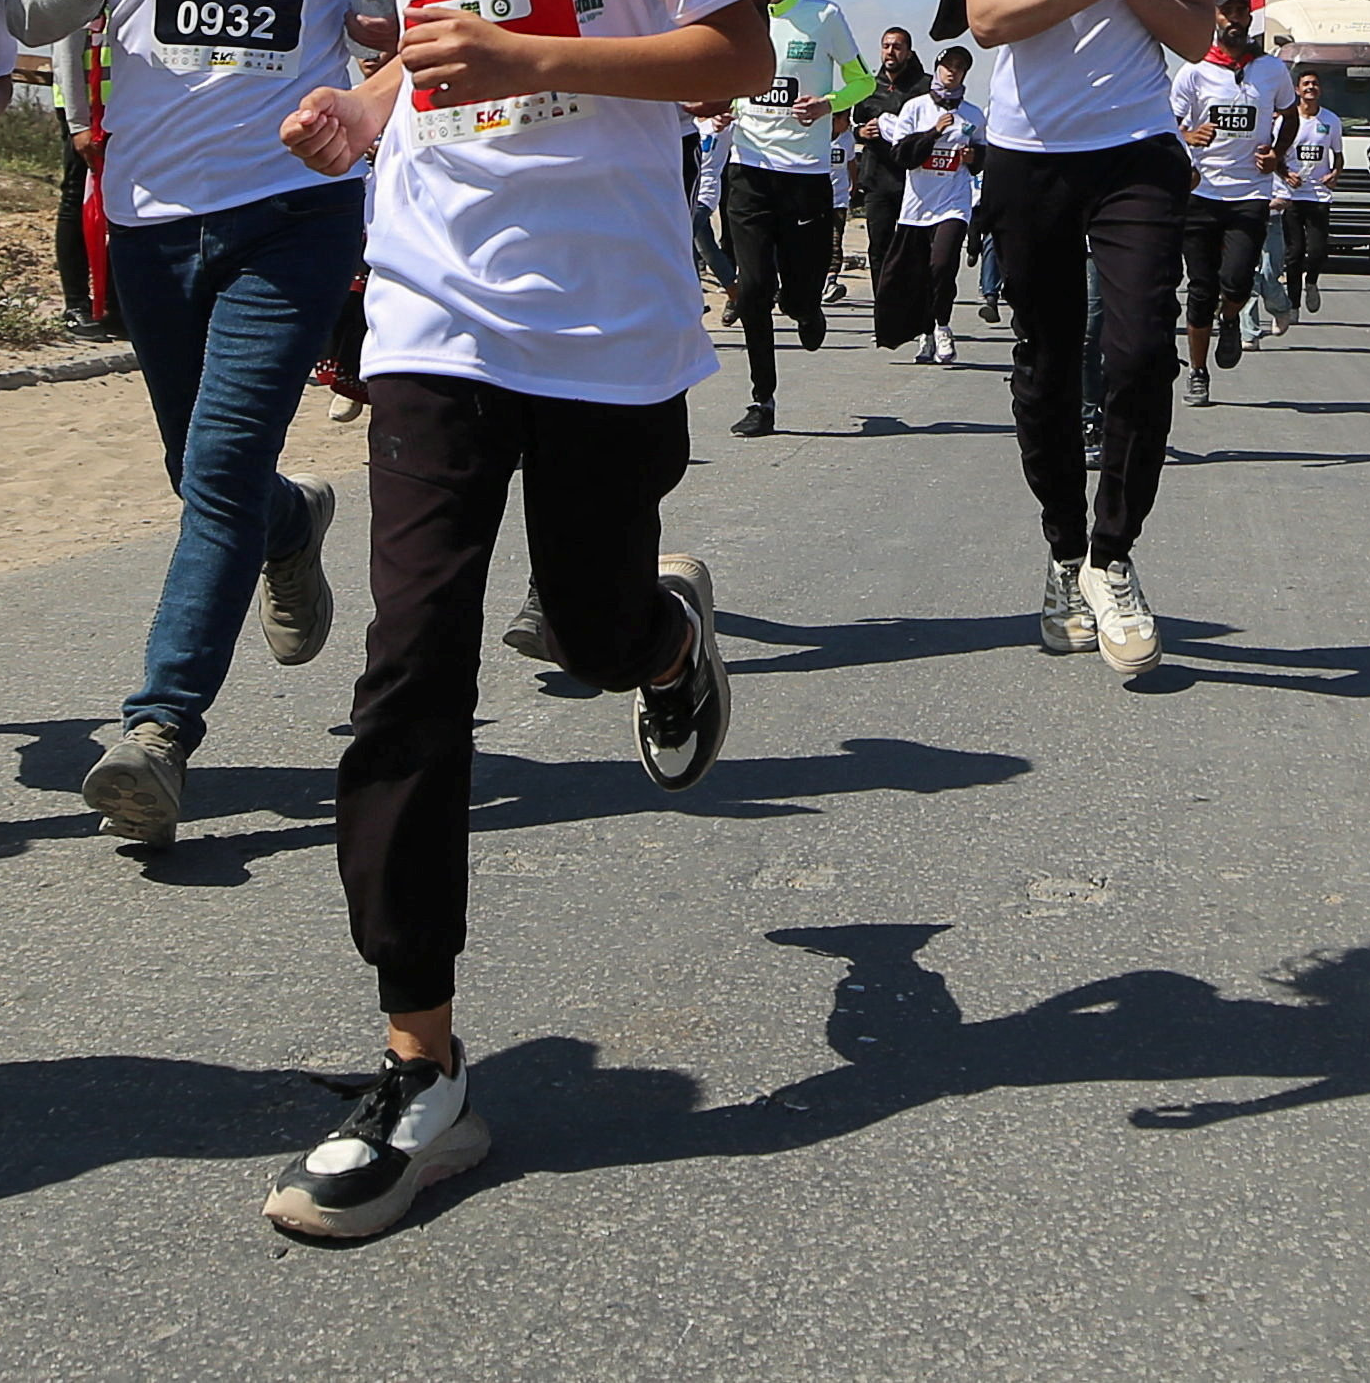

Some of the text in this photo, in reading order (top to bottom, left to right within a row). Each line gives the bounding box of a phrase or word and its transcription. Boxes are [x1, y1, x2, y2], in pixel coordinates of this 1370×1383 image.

[177, 0, 276, 40] 0932
[1217, 115, 1248, 128] 1150
[931, 157, 953, 169] 597
